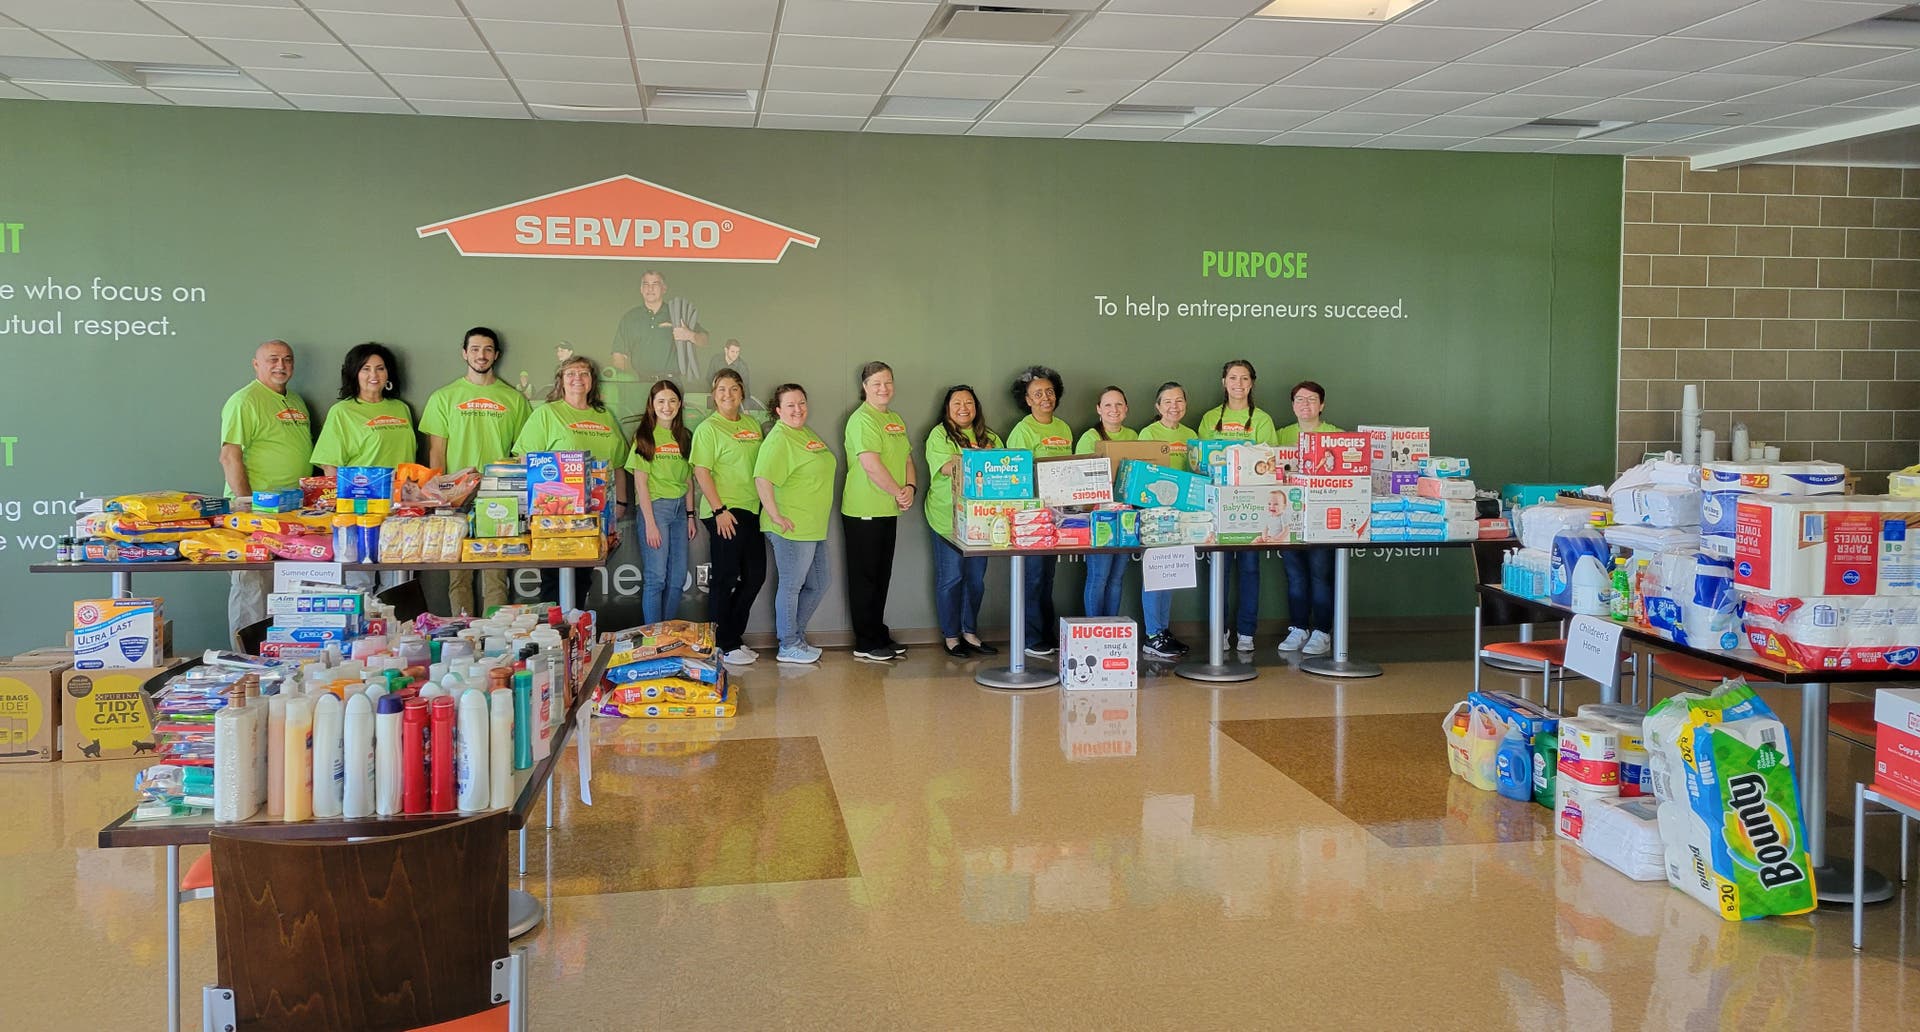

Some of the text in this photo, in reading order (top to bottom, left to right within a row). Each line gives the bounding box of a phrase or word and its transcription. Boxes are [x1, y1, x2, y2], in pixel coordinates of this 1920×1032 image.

[1202, 250, 1308, 279] PURPOSE
[24, 276, 82, 301] who
[91, 276, 163, 302] focus
[172, 286, 207, 302] on
[1094, 295, 1409, 322] To help entrepreneurs succeed.
[74, 315, 177, 341] respect.
[466, 401, 499, 410] SERVPRO
[1320, 435, 1366, 448] HUGGIES
[1392, 431, 1430, 440] HUGGIES
[529, 455, 553, 469] Ziploc
[563, 463, 583, 473] 208
[984, 461, 1019, 475] Pampers
[1310, 478, 1354, 488] HUGGIES
[1753, 475, 1768, 485] 72
[1072, 490, 1111, 500] HUGGIES
[1223, 502, 1265, 512] Baby Wipes
[1834, 534, 1873, 544] TOWELS
[1837, 544, 1869, 554] PAPER
[1152, 552, 1185, 561] United Way
[1175, 561, 1190, 570] Baby
[280, 568, 335, 578] Sumner County
[109, 620, 133, 636] LAST
[1072, 625, 1133, 639] HUGGIES
[1579, 622, 1609, 642] Children's
[78, 632, 107, 646] ULTRA
[1582, 640, 1601, 655] Home
[104, 692, 139, 700] PURINA
[95, 700, 139, 713] TIDY
[94, 711, 140, 724] CATS
[1561, 738, 1579, 752] Ultra
[1898, 743, 1913, 757] Copy
[1728, 772, 1804, 890] Bounty
